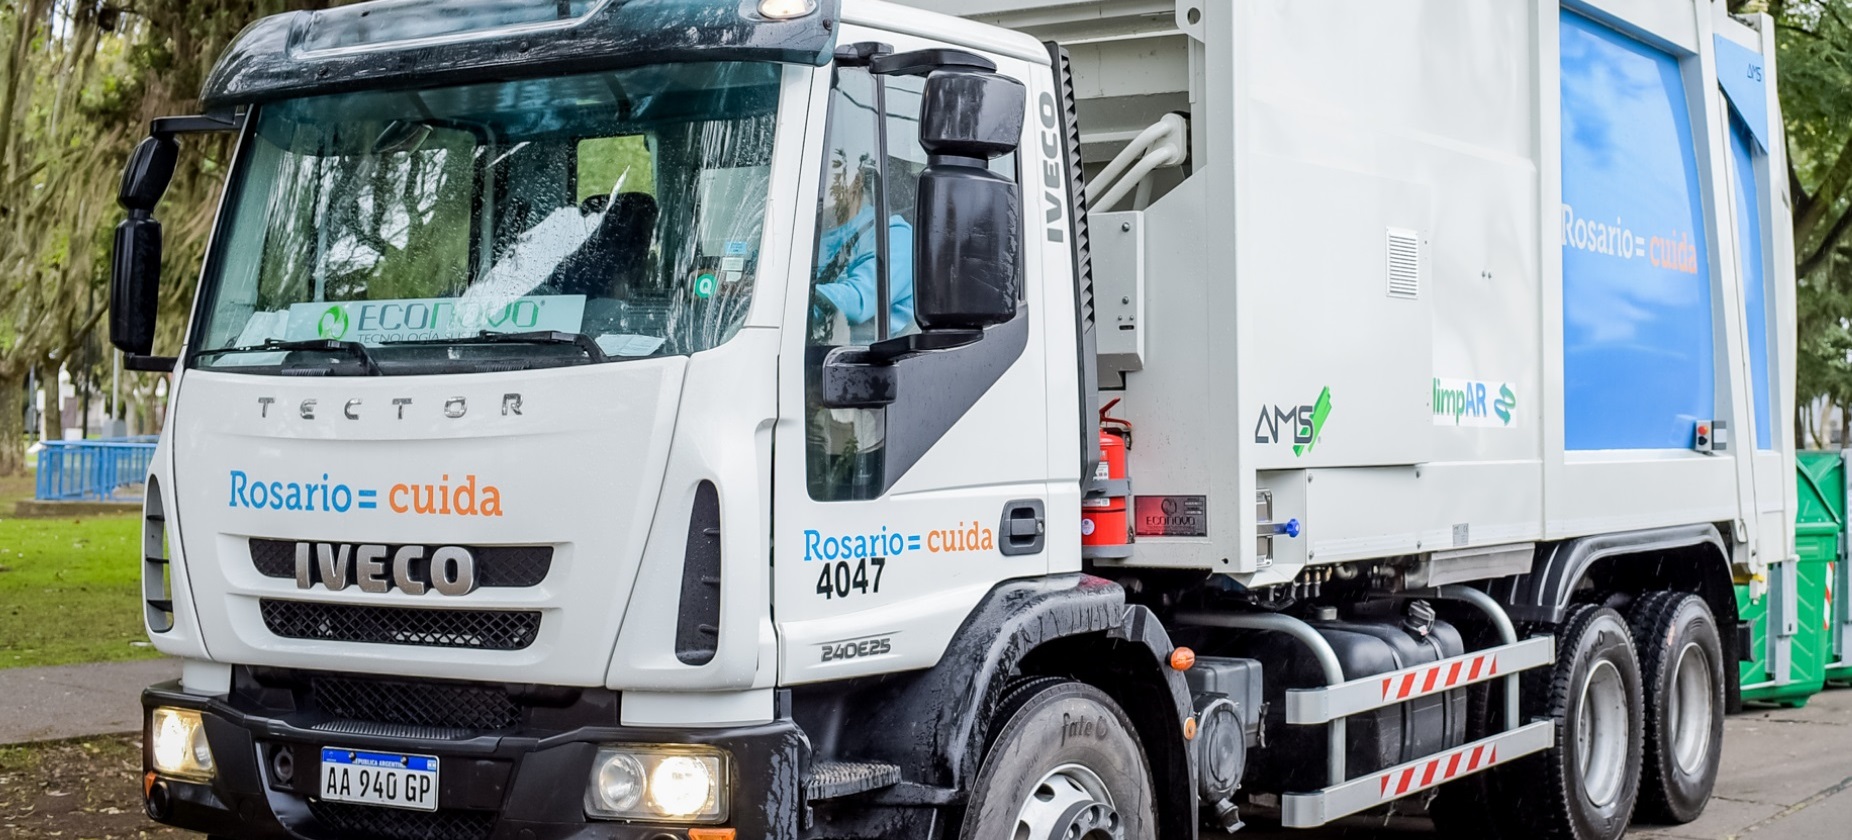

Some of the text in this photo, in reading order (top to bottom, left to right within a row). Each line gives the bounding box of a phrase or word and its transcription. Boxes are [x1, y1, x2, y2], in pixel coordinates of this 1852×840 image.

[1039, 91, 1064, 243] IVECO
[1650, 228, 1698, 275] cuida
[699, 277, 713, 295] Q
[257, 393, 524, 420] TECTOR
[1432, 377, 1487, 426] limpAR
[1255, 404, 1314, 444] AMS
[389, 474, 503, 517] cuida
[927, 521, 994, 552] cuida
[295, 541, 480, 596] IVECO
[816, 557, 886, 600] 4047
[821, 638, 891, 662] 240E25
[326, 766, 431, 803] AA 940 GP
